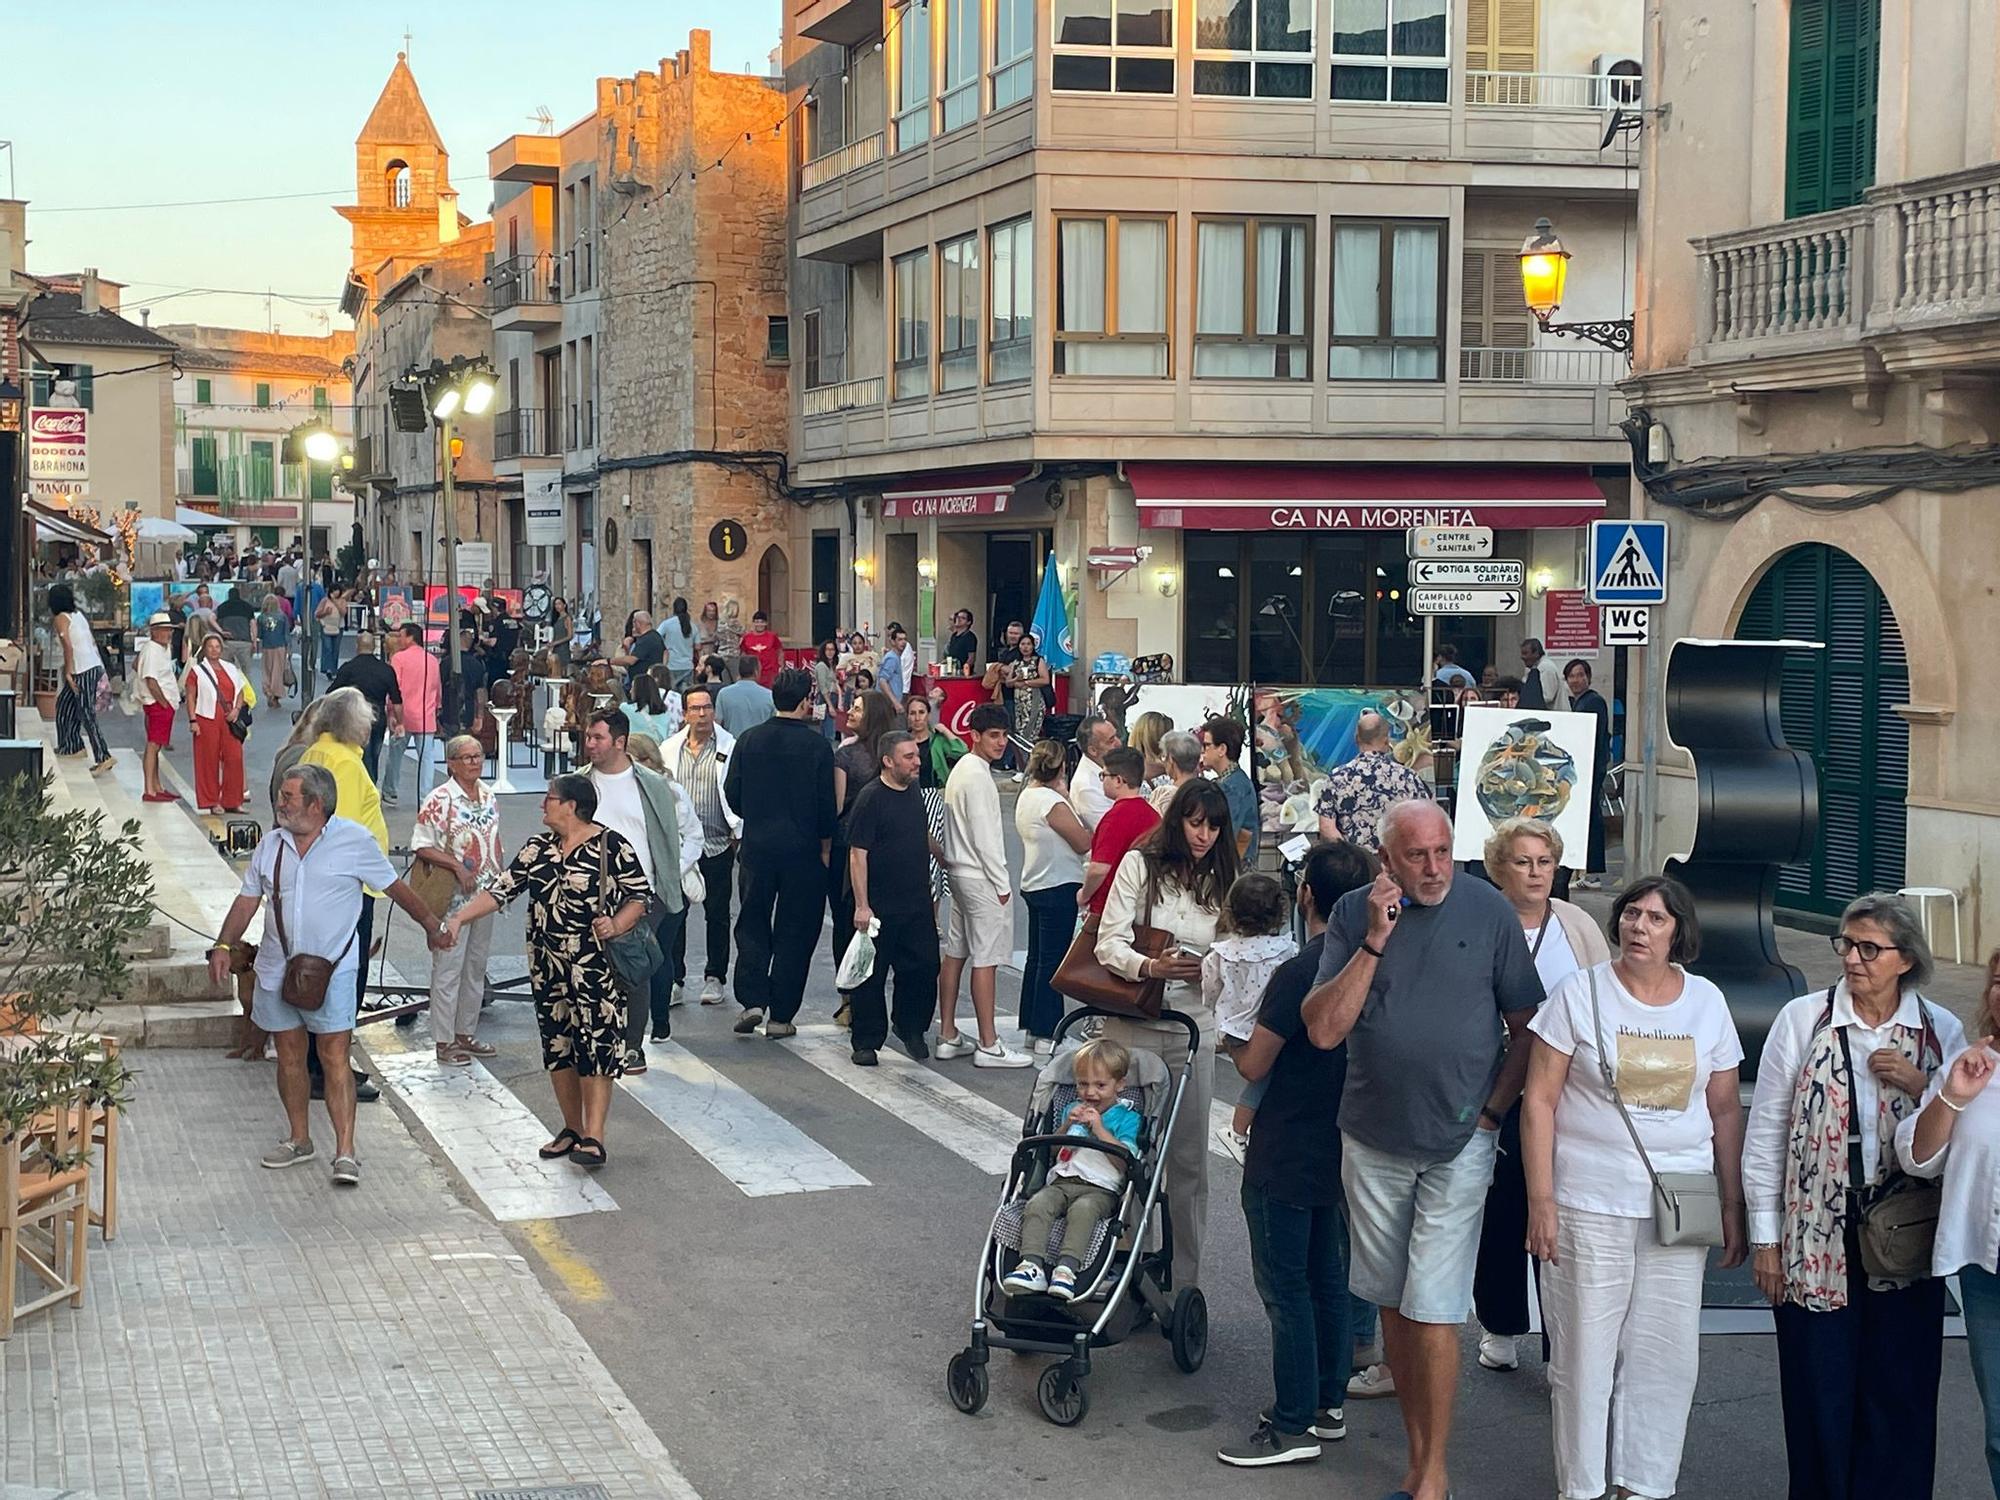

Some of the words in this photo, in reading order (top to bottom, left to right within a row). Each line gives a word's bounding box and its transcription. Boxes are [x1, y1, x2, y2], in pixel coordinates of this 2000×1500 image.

[32, 448, 86, 456] BODEGA
[33, 460, 86, 472] BARAHONA
[912, 500, 923, 516] CA
[925, 498, 938, 515] NA
[939, 496, 977, 514] MORENETA
[1271, 508, 1306, 527] CA
[1316, 508, 1351, 527] NA
[1361, 508, 1476, 527] MORENETA
[1436, 533, 1470, 541] CENTRE
[1436, 544, 1476, 552] SANITARI
[1437, 565, 1471, 573] BOTIGA
[1477, 574, 1519, 582] CARITAS
[1418, 592, 1472, 601] CAMPLLADÓ
[1418, 602, 1460, 610] MUEBLES
[1612, 610, 1647, 627] WC
[1619, 1024, 1694, 1041] Rebellious
